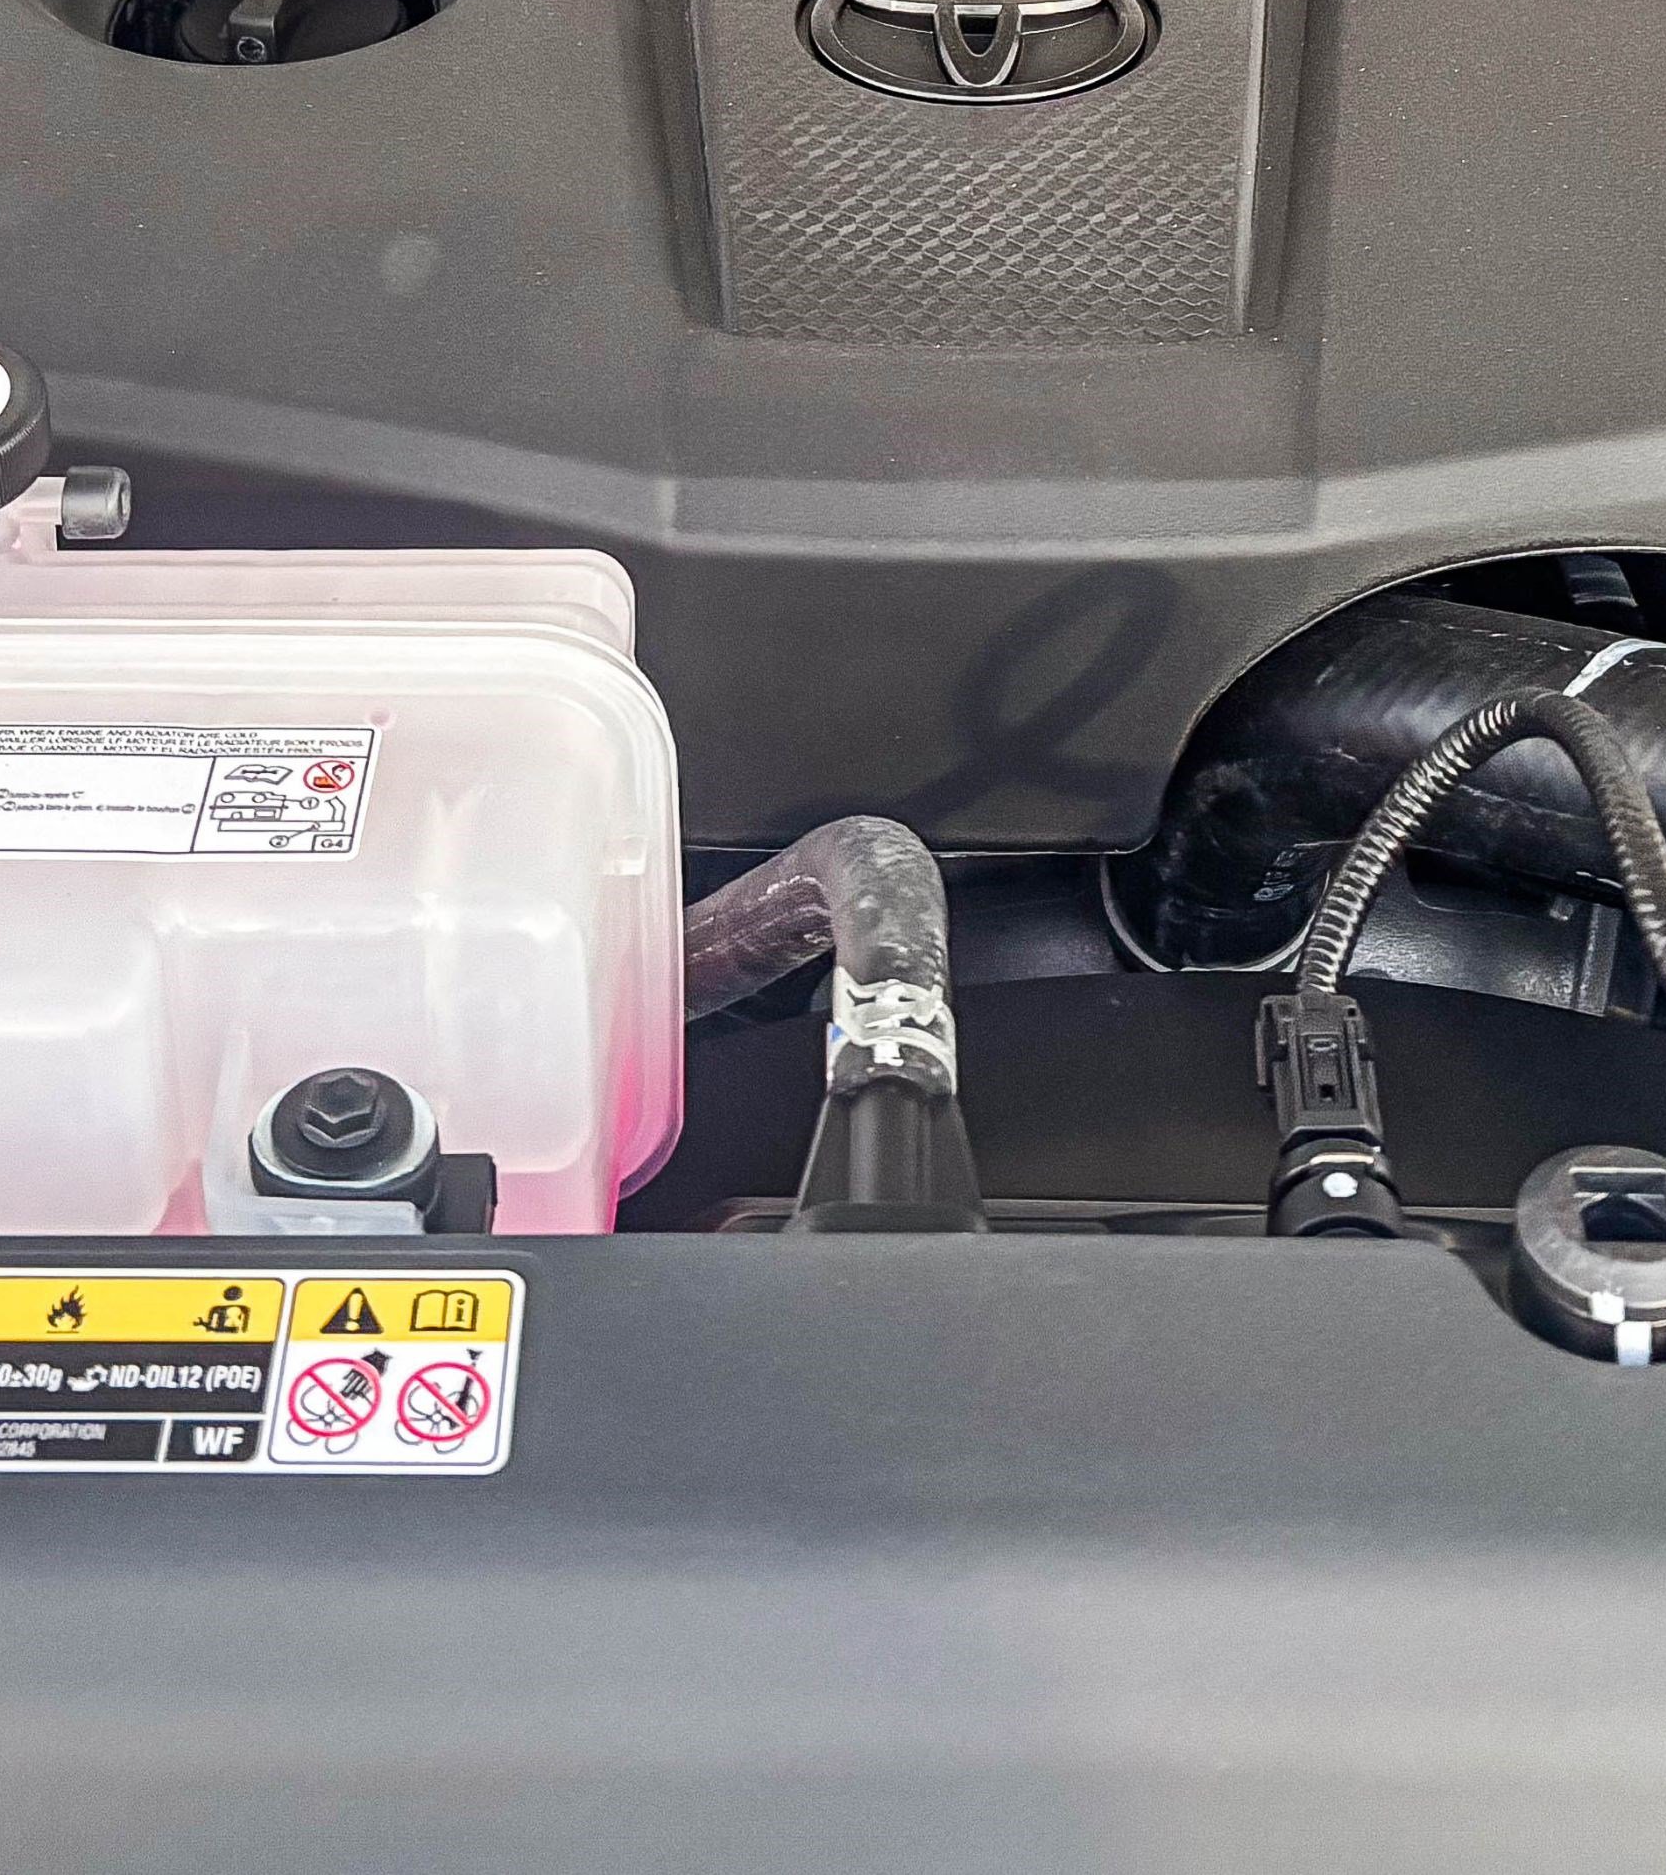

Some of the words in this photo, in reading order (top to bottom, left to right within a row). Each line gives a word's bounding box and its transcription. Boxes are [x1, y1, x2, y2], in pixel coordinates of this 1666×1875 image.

[58, 729, 103, 737] ENGINE
[106, 729, 133, 737] AND
[109, 1363, 201, 1389] ND-OIL12
[204, 1364, 263, 1393] (POE)
[192, 1425, 244, 1457] WF
